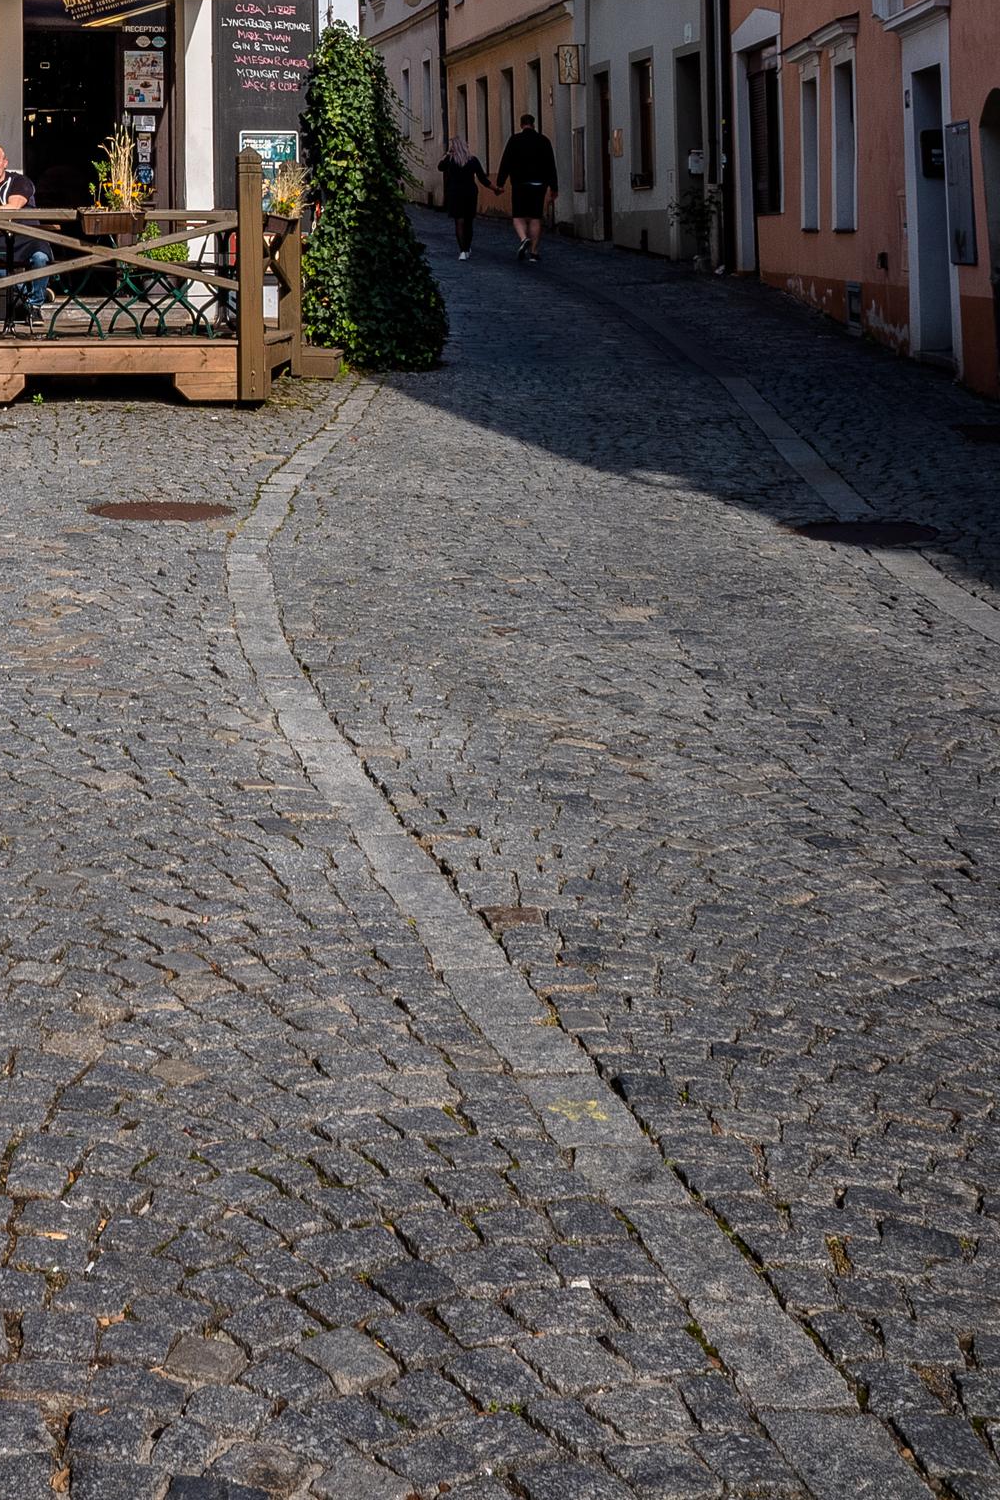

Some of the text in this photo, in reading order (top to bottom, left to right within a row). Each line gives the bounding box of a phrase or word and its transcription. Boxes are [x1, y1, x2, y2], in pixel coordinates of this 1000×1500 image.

[235, 4, 265, 16] CUBA
[264, 33, 291, 42] TWAIN
[232, 42, 250, 51] GIN
[262, 44, 289, 53] TONIC
[283, 70, 300, 80] SUN
